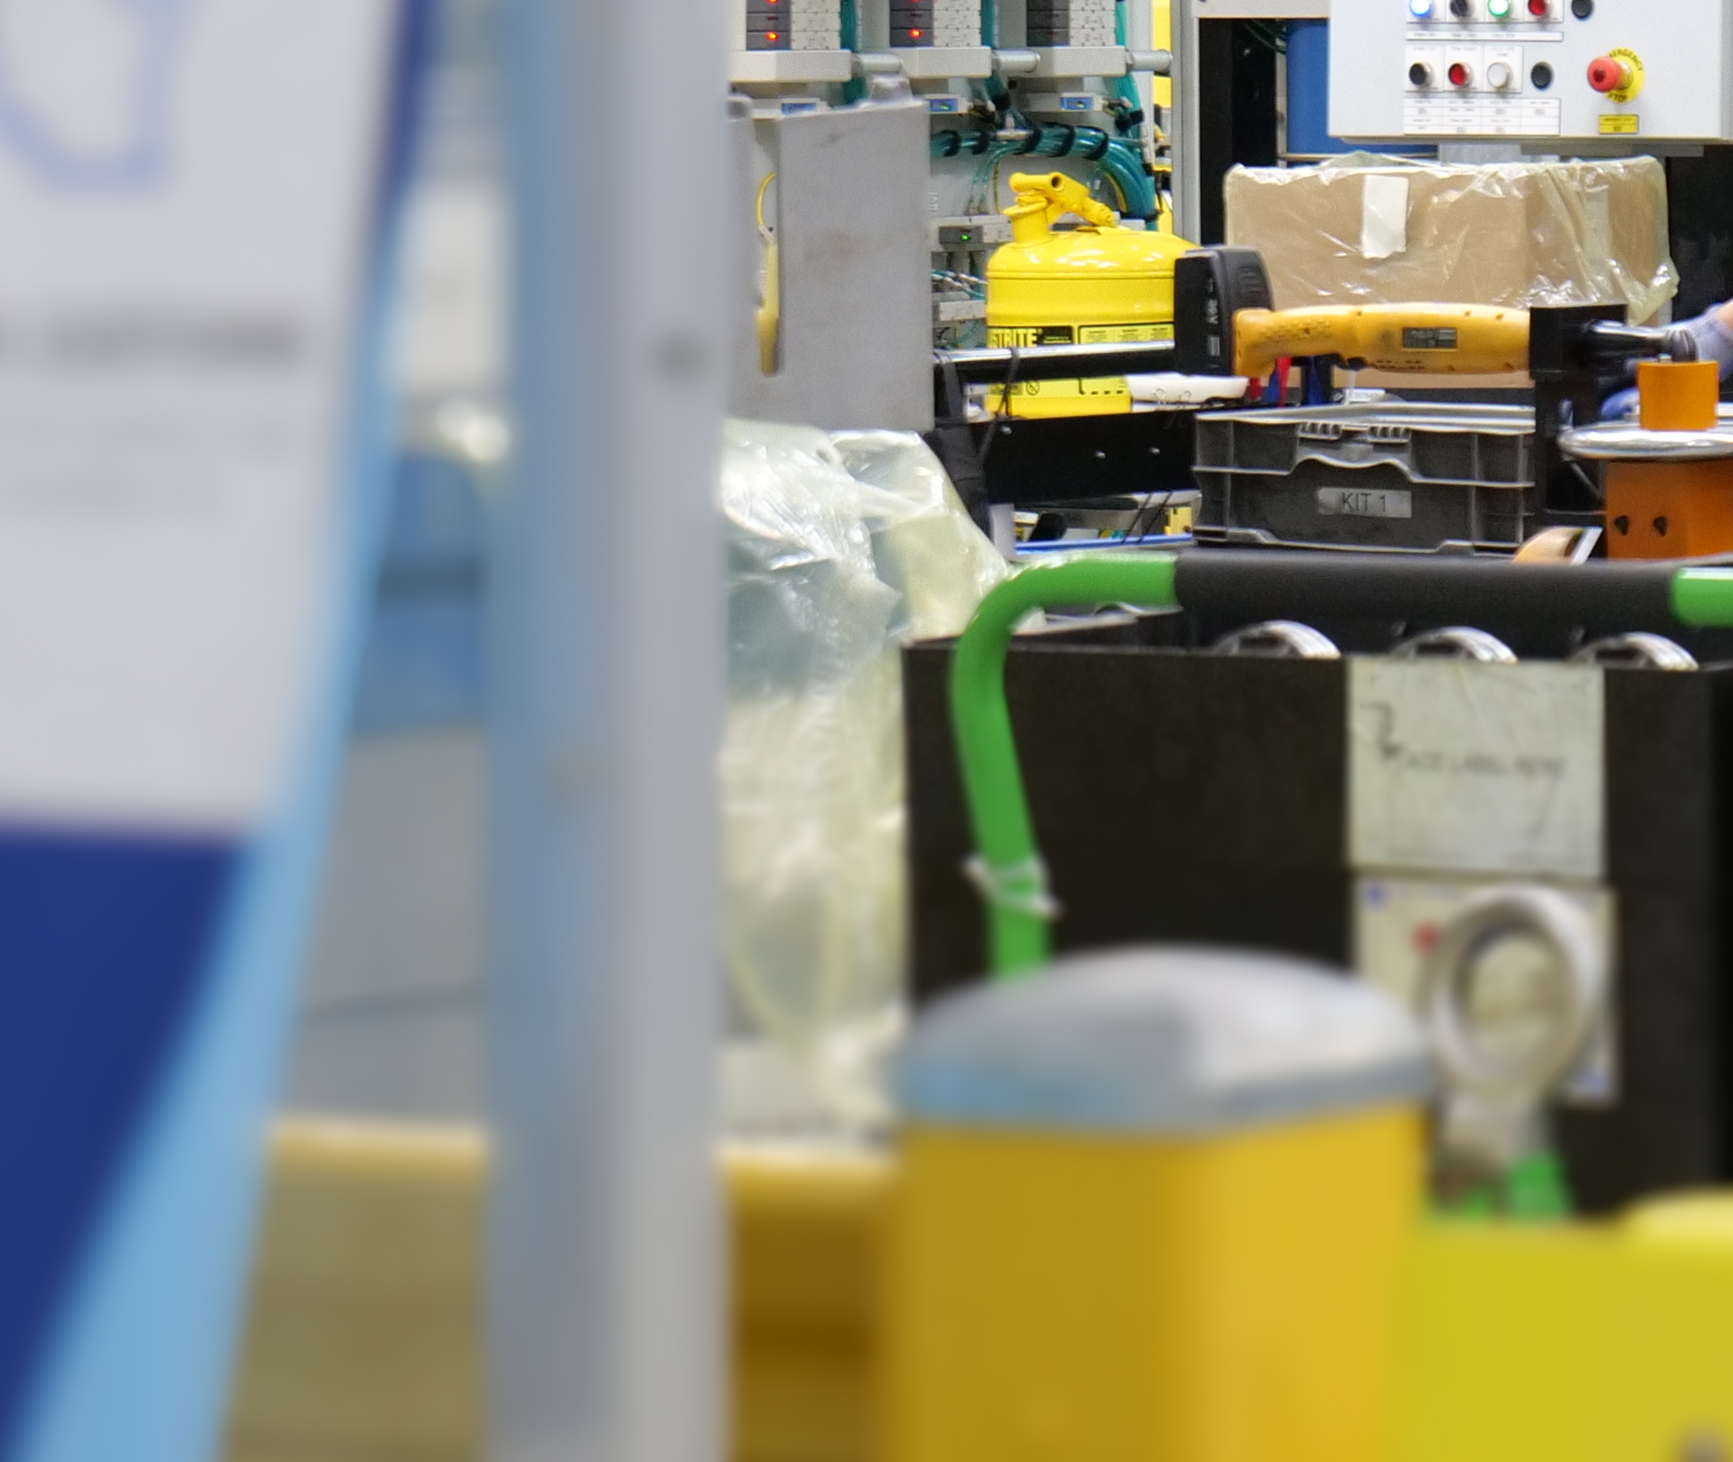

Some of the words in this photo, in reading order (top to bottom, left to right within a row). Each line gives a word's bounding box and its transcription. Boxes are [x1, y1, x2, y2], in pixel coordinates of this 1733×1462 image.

[1608, 47, 1644, 72] ERGENCY
[1341, 491, 1372, 513] KIT
[1379, 494, 1387, 512] 1
